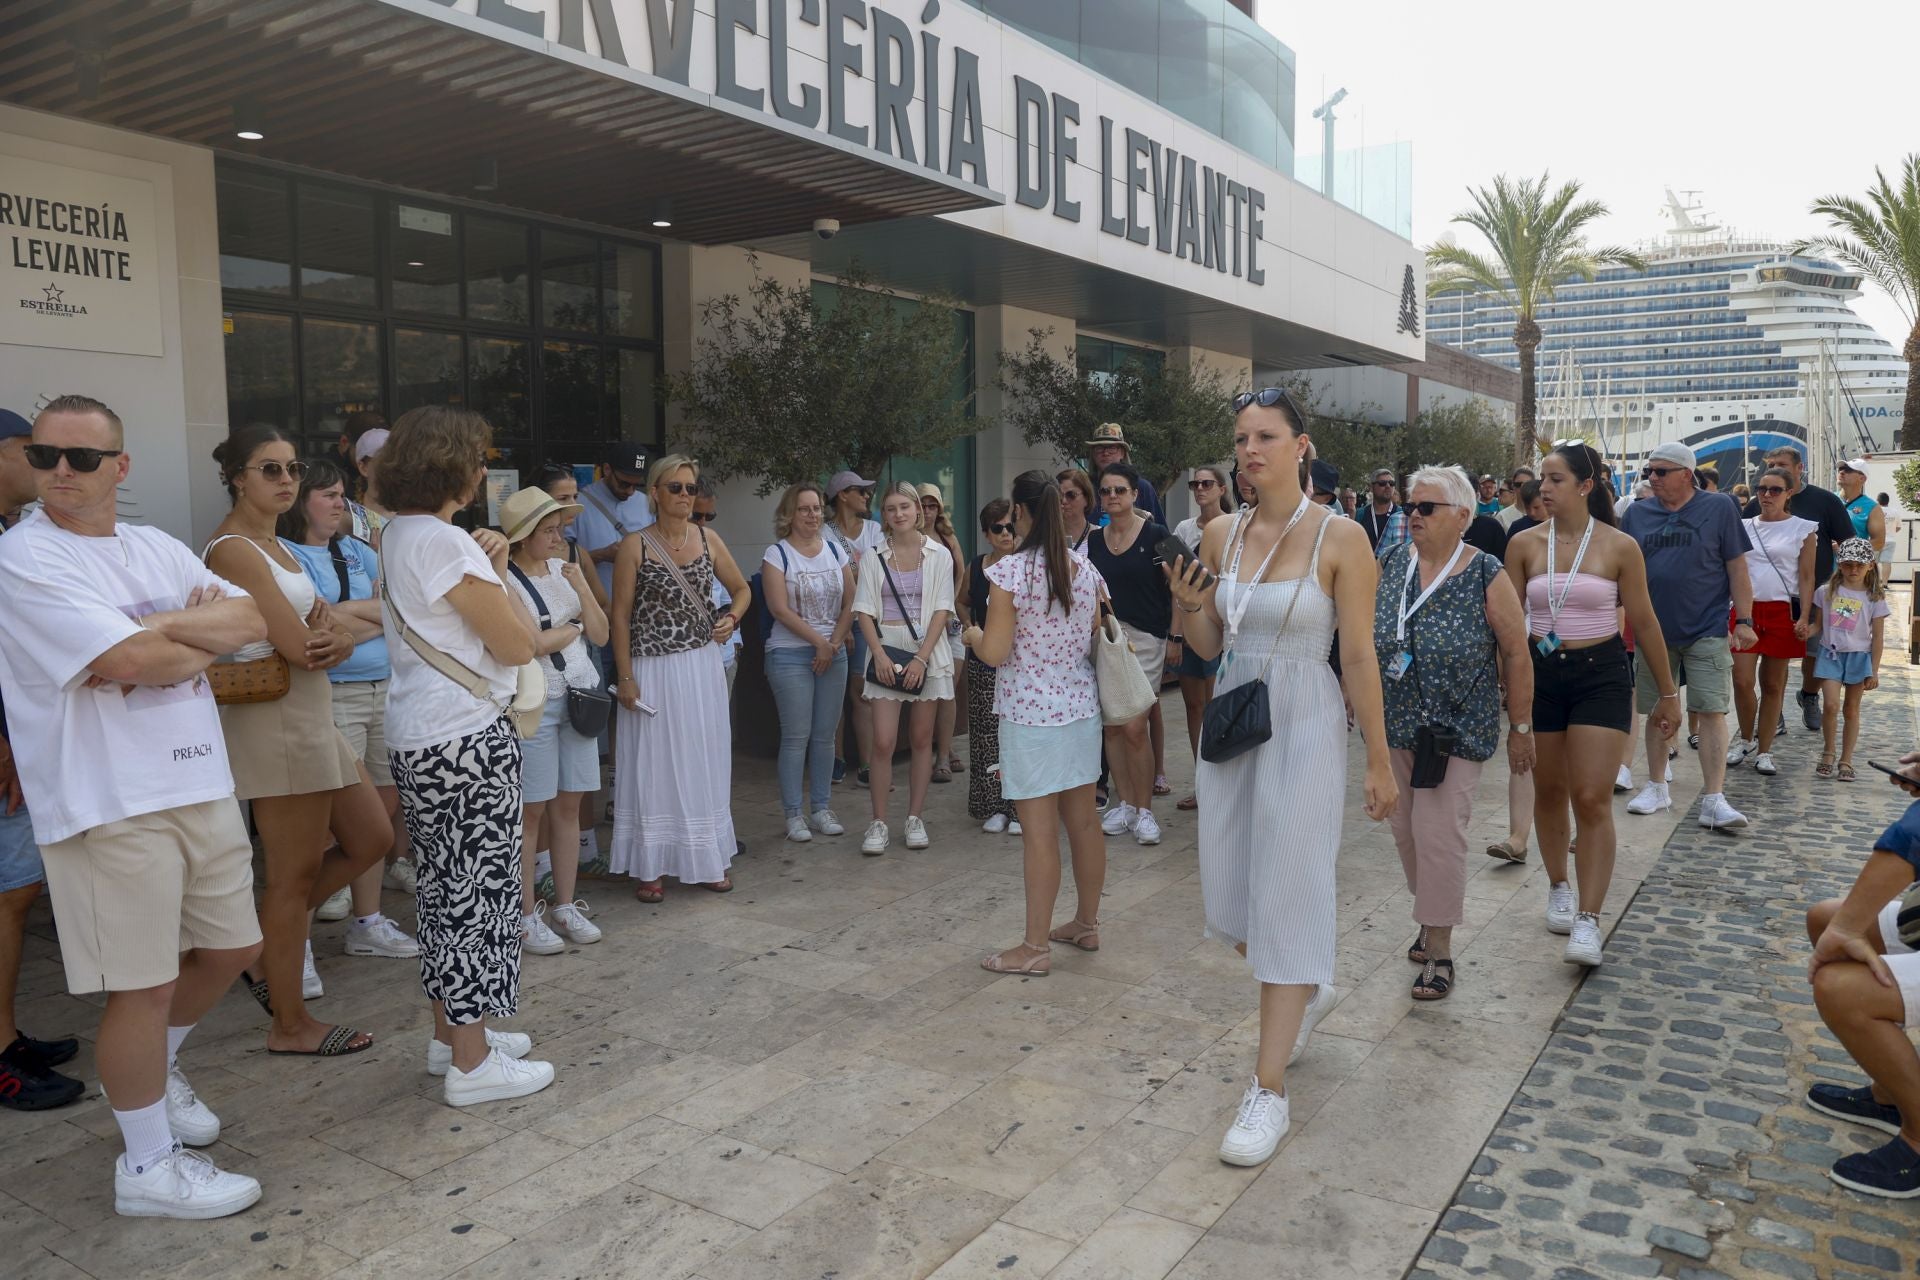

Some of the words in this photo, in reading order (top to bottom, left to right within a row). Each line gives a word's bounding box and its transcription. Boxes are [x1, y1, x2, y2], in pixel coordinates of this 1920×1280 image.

[430, 0, 990, 189] VECERÍA
[1014, 75, 1081, 222] DE
[1100, 115, 1265, 286] LEVANTE
[12, 236, 132, 281] LEVANTE
[20, 300, 88, 314] ESTRELLA
[1643, 532, 1692, 548] PUMA
[173, 744, 212, 761] PREACH
